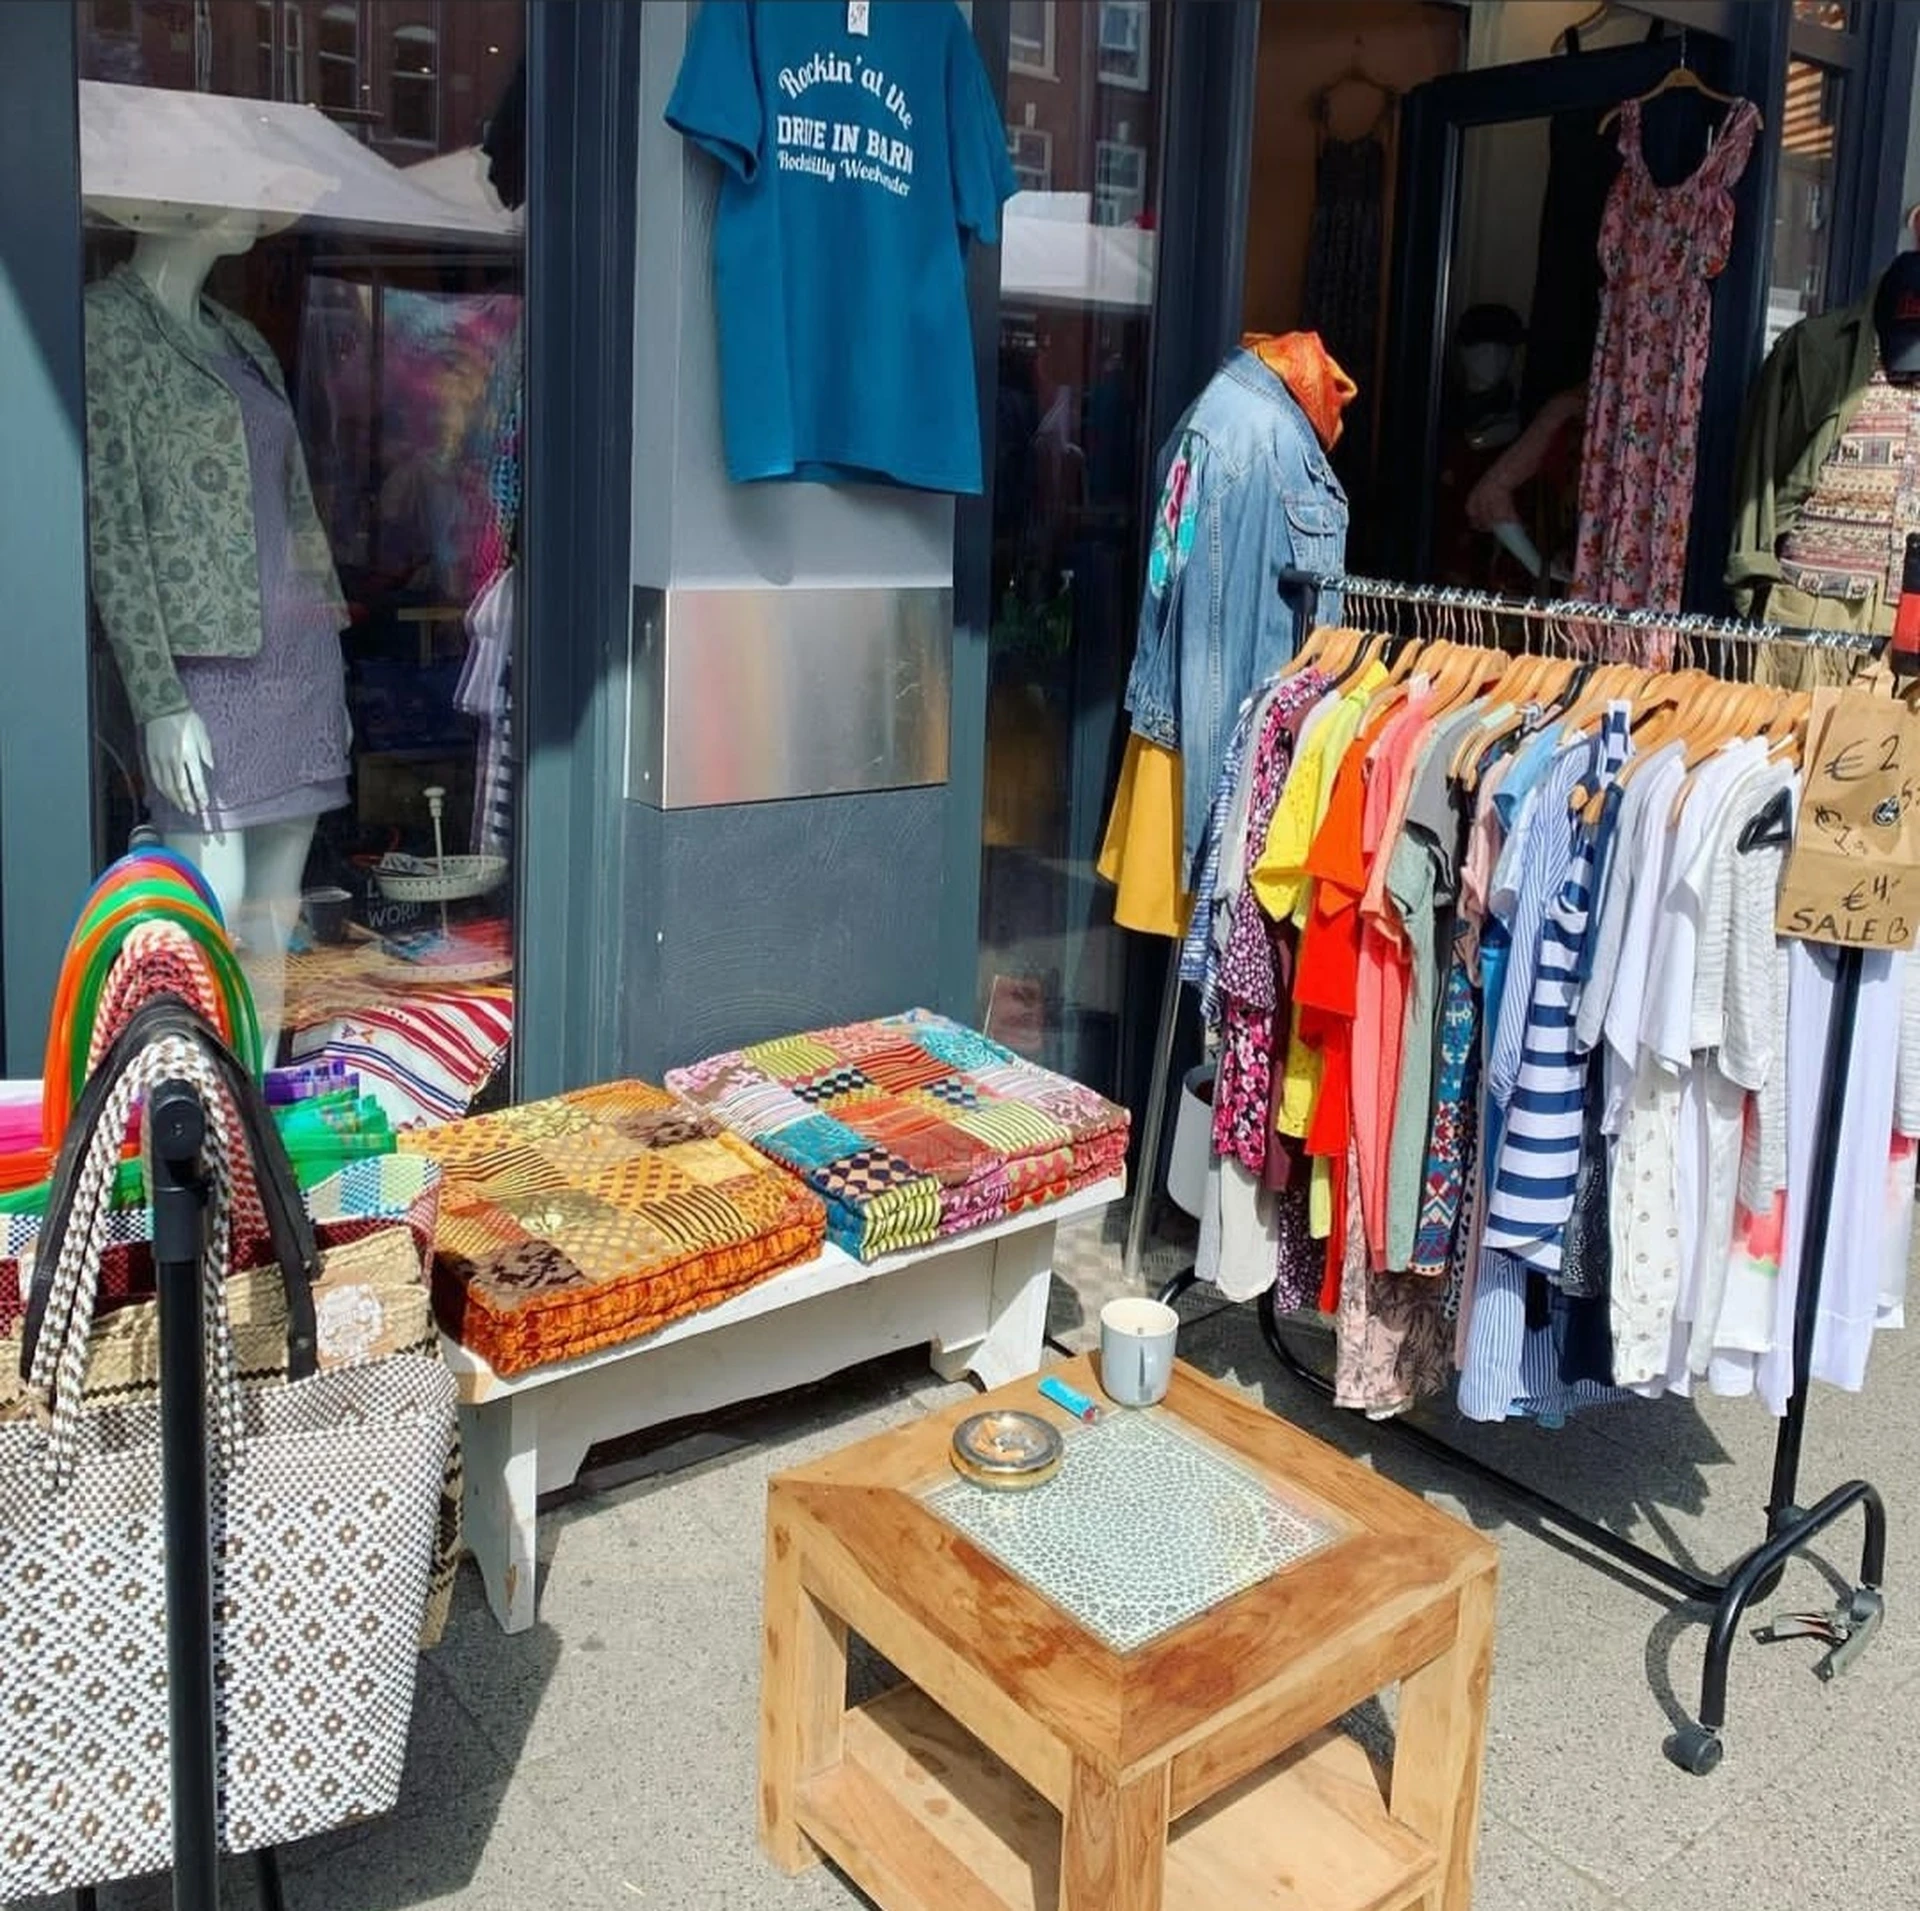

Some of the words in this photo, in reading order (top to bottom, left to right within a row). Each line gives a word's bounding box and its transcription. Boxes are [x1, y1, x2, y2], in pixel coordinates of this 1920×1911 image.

[861, 67, 883, 97] at
[885, 82, 913, 130] the
[831, 122, 861, 154] IN
[866, 127, 913, 175] BARN
[1786, 907, 1878, 942] SALE
